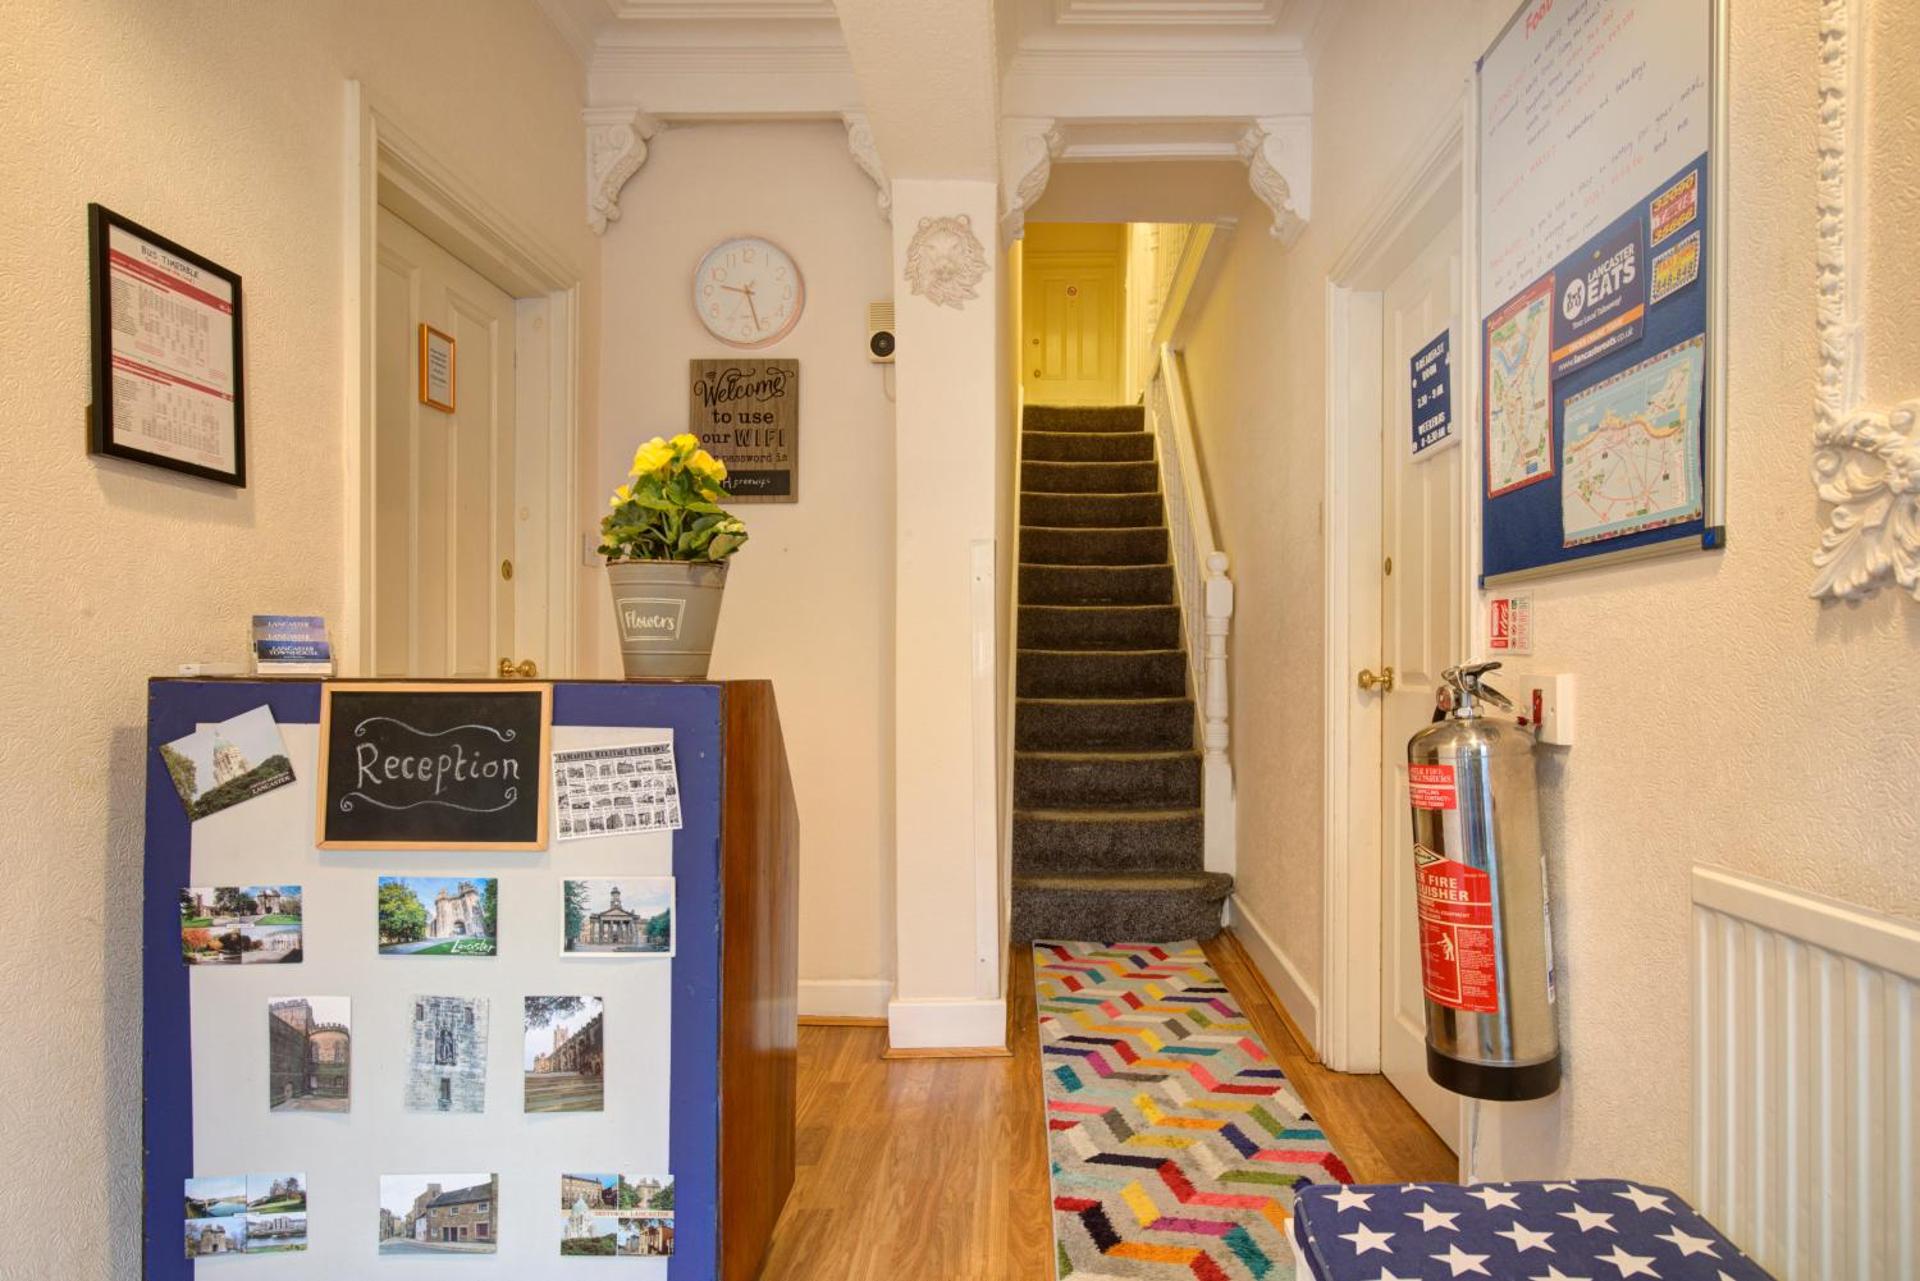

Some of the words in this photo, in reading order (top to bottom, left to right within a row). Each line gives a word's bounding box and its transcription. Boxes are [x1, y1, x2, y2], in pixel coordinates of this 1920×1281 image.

[725, 253, 736, 268] 11
[742, 247, 756, 264] 12
[1587, 242, 1635, 282] LANCASTER
[709, 266, 728, 282] 10
[1586, 255, 1636, 307] EATS
[694, 367, 794, 408] Welcome
[713, 409, 732, 425] to
[738, 411, 775, 425] use
[702, 432, 731, 445] our
[734, 429, 785, 448] WIFI
[775, 450, 788, 463] is
[624, 610, 676, 631] Flowers
[356, 742, 521, 796] Reception
[1428, 874, 1458, 889] FIRE
